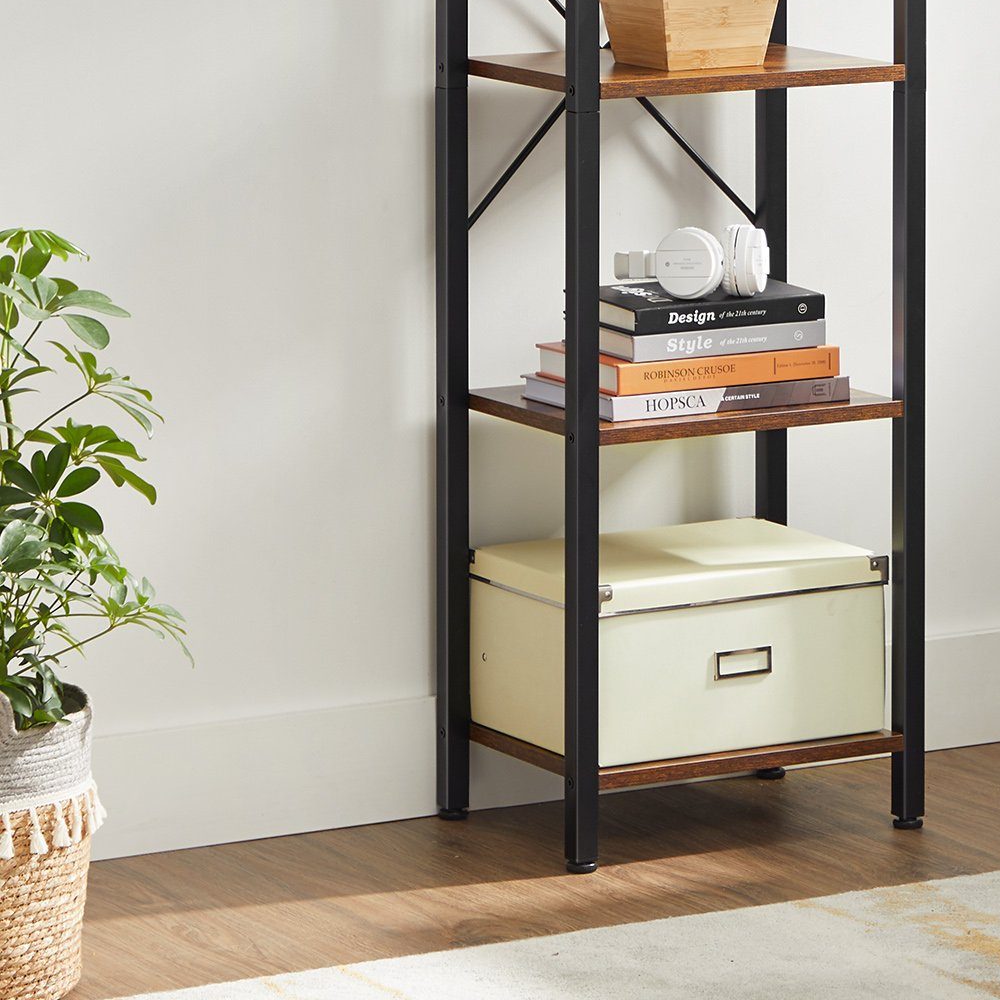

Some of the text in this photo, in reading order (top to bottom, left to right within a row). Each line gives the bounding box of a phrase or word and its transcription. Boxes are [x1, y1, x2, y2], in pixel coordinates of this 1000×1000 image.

[667, 309, 716, 326] Design
[726, 310, 735, 318] the
[746, 308, 767, 317] century
[666, 335, 714, 354] Style
[719, 338, 726, 346] of
[747, 335, 768, 344] century
[643, 364, 736, 381] ROBINSON CRUSOE
[645, 395, 706, 412] HOPSCA
[724, 394, 745, 402] CERTAIN
